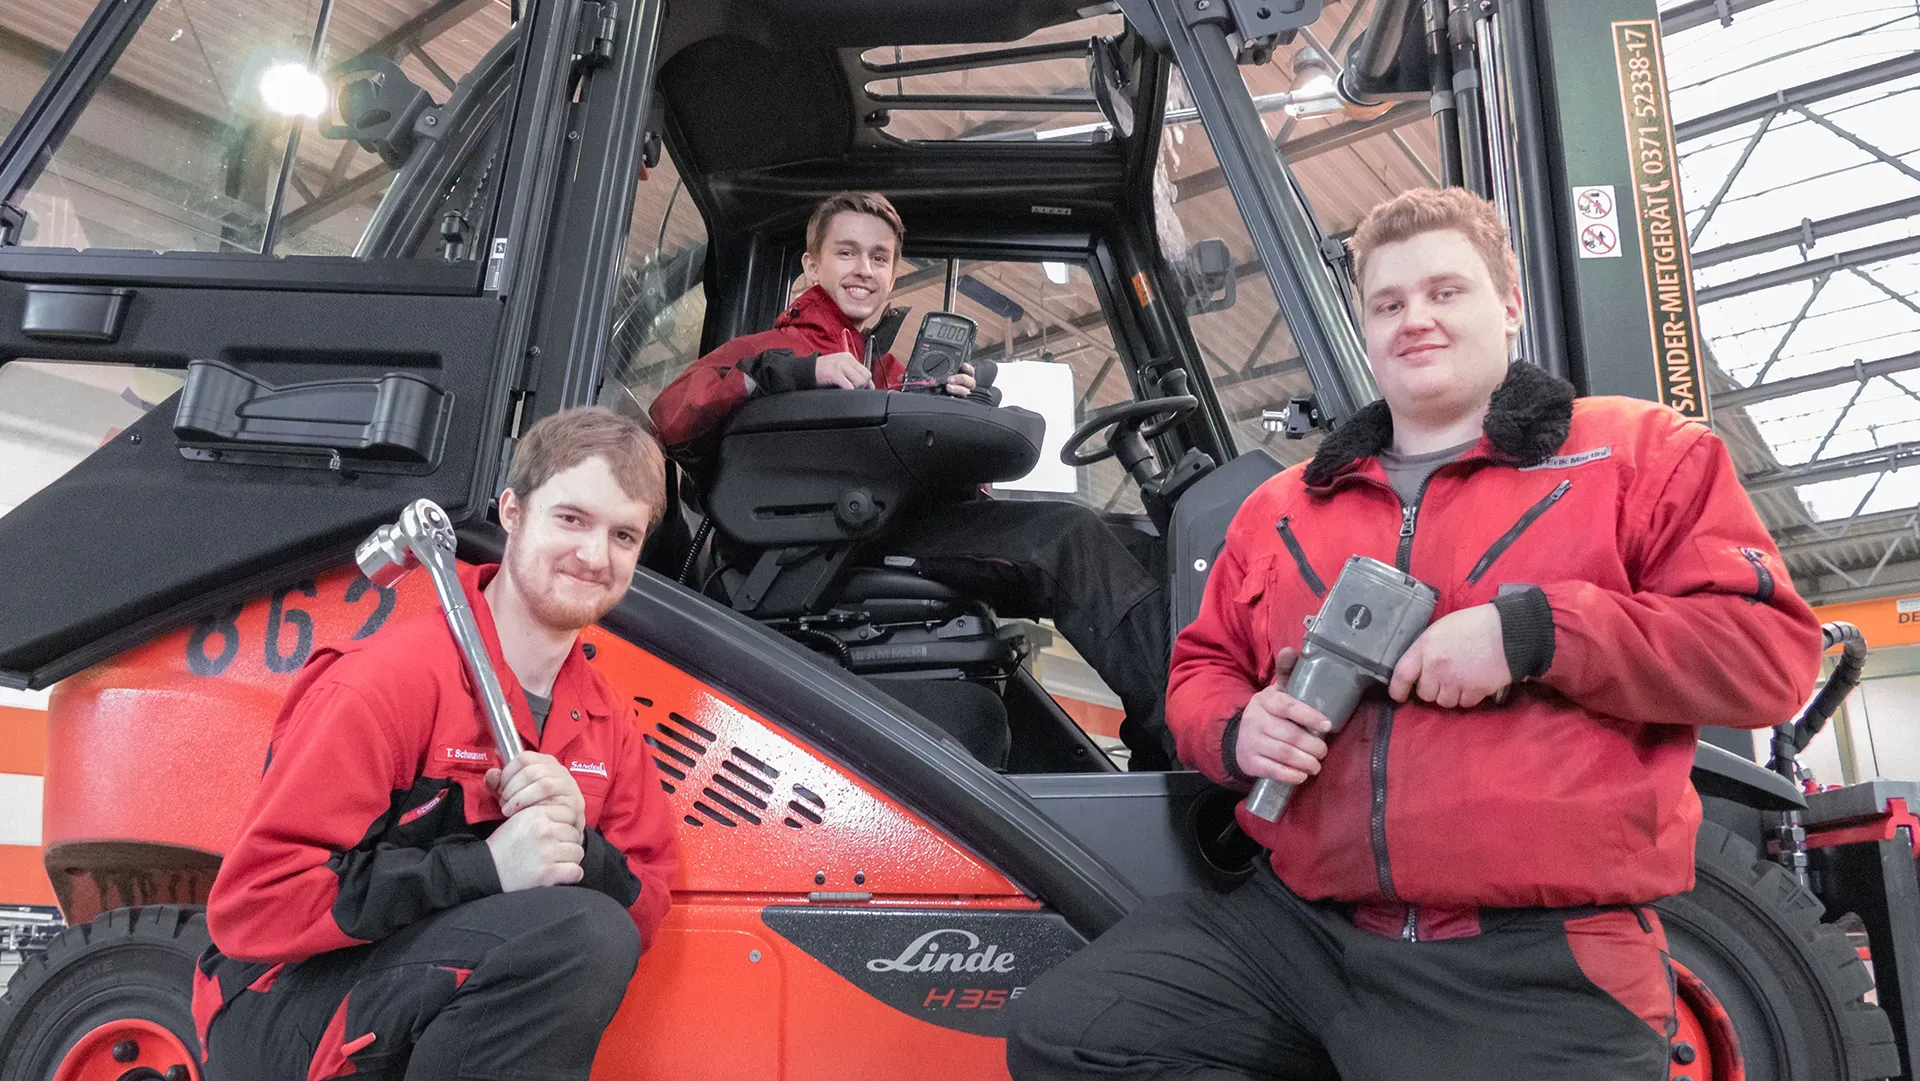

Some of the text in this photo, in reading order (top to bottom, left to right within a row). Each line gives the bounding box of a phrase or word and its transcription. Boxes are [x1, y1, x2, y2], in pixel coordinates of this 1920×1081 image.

[1624, 28, 1696, 413] SANDER-MIETGERÄT 0371 52338-17
[866, 928, 1015, 973] Linde
